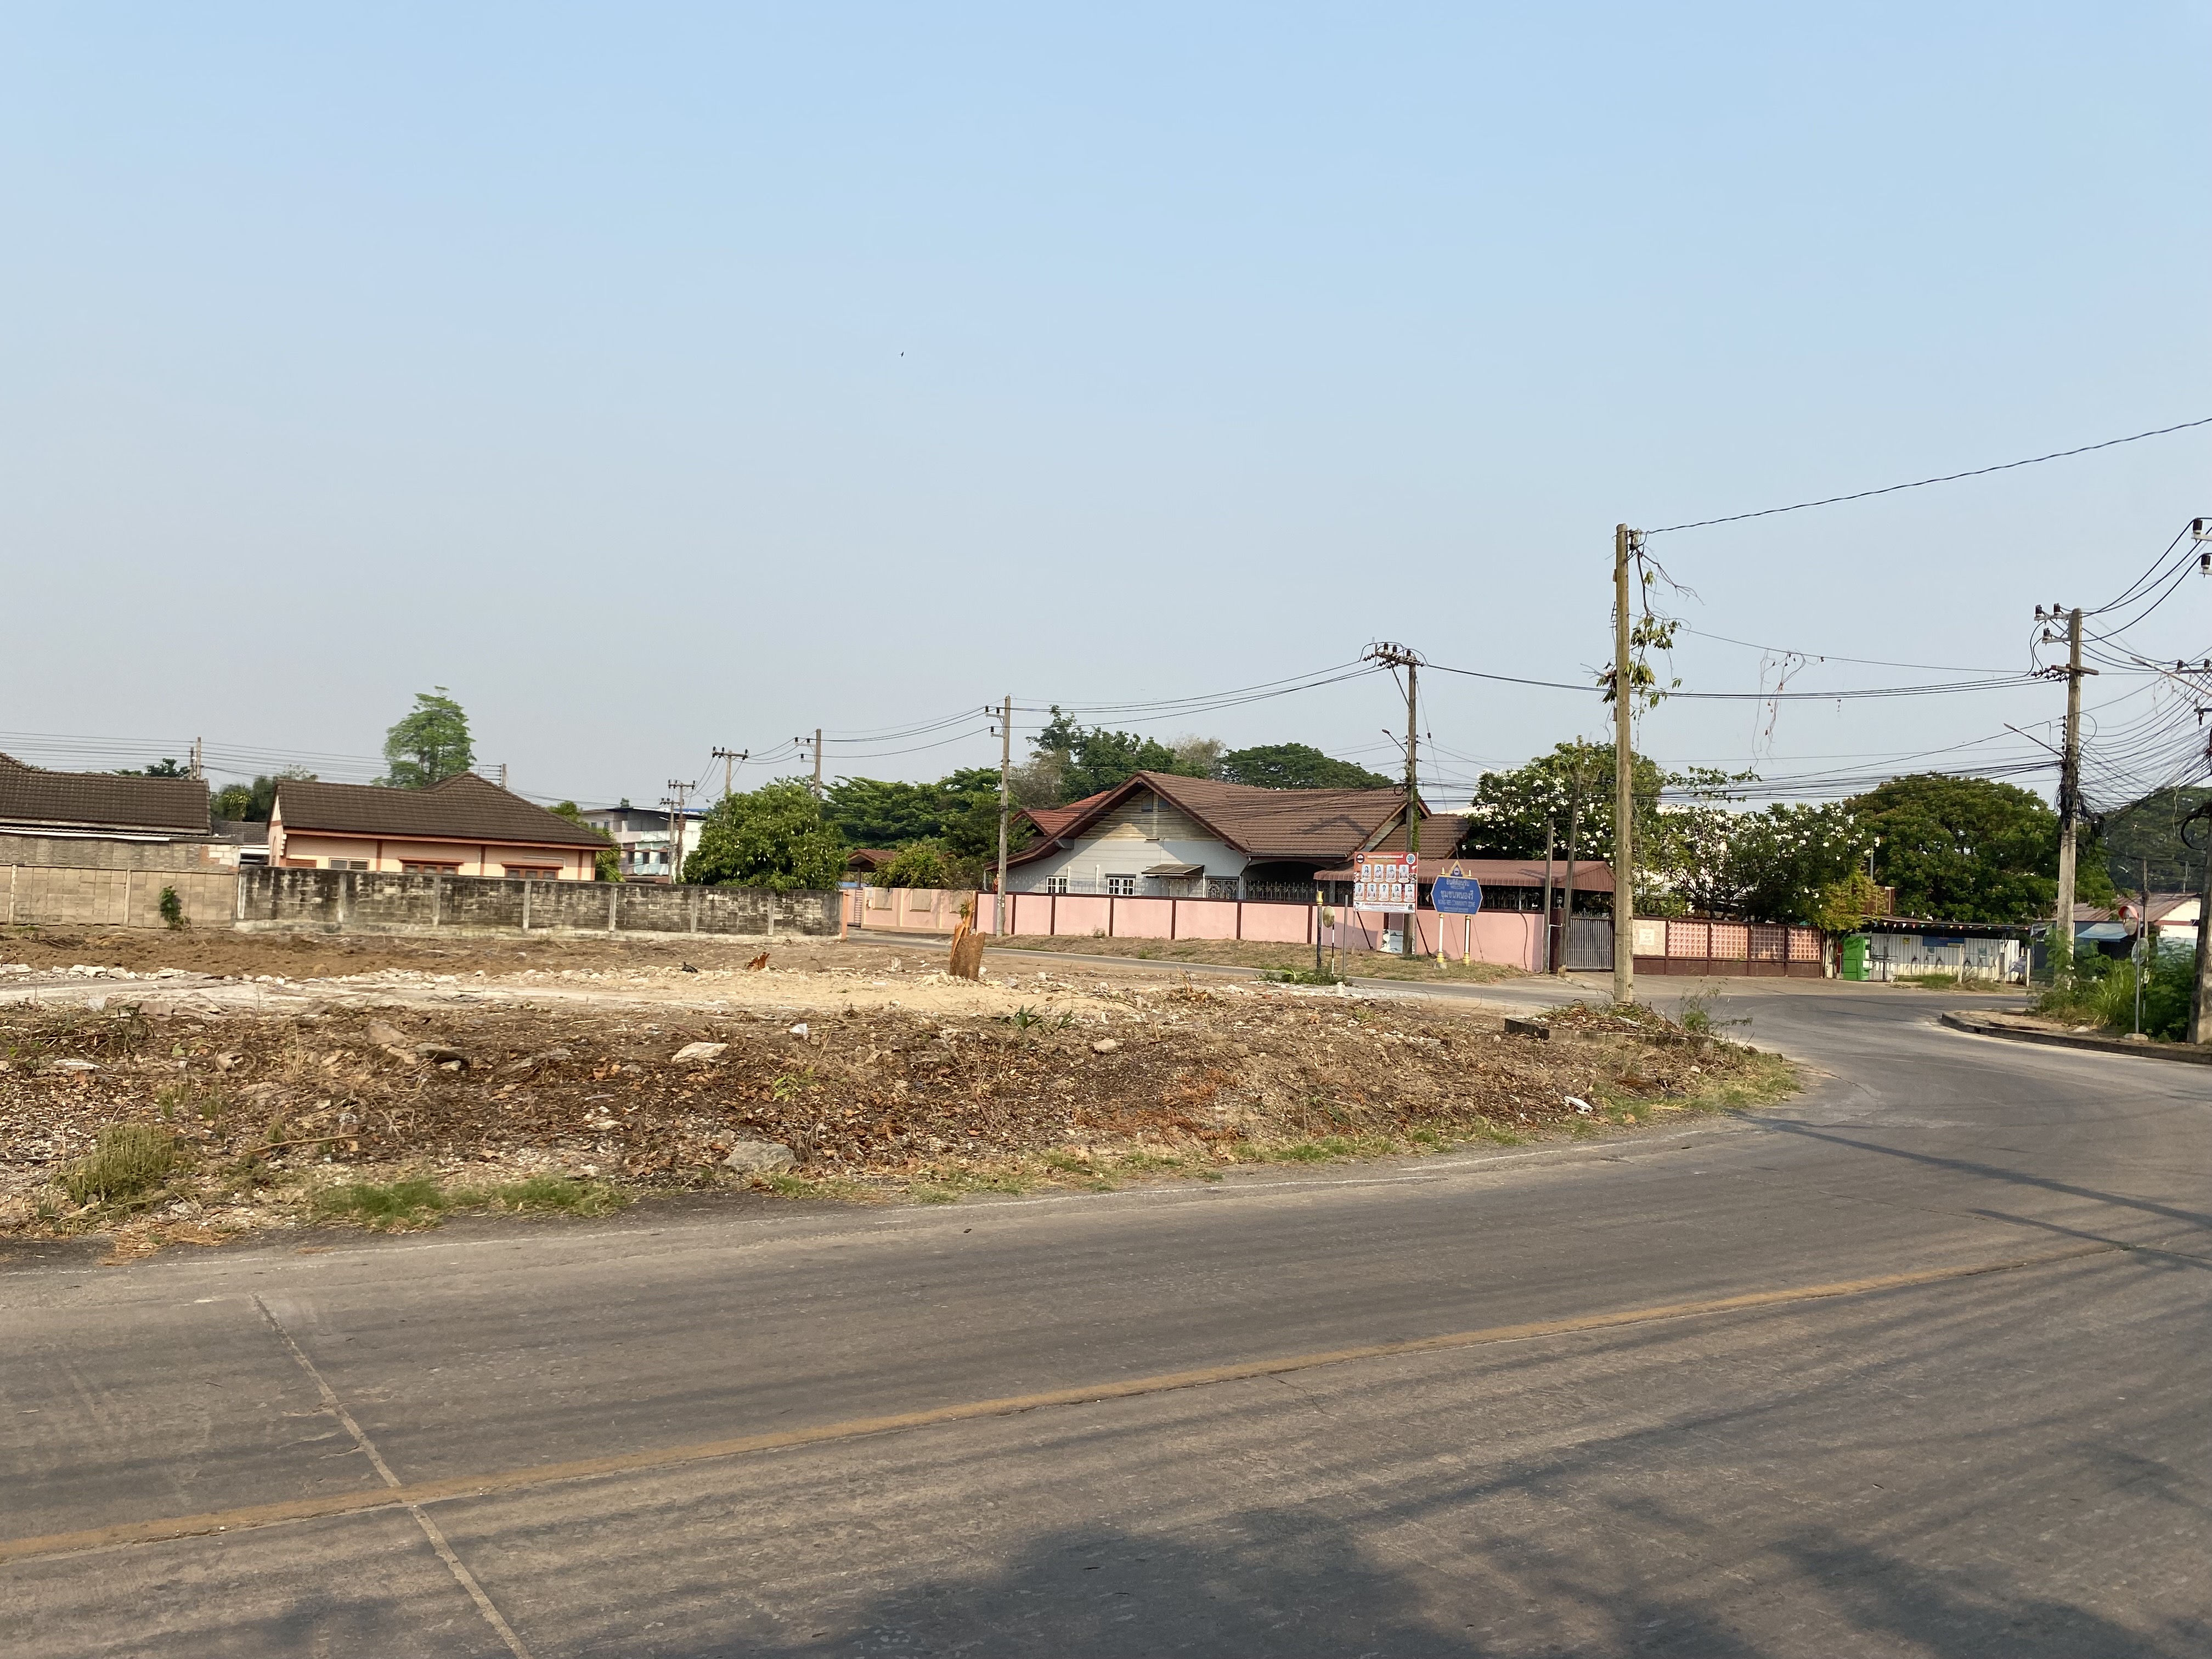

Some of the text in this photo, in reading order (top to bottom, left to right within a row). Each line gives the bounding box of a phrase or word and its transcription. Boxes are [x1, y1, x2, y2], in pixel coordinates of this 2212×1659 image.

[1441, 890, 1474, 900] ชุมชนหนองรี
